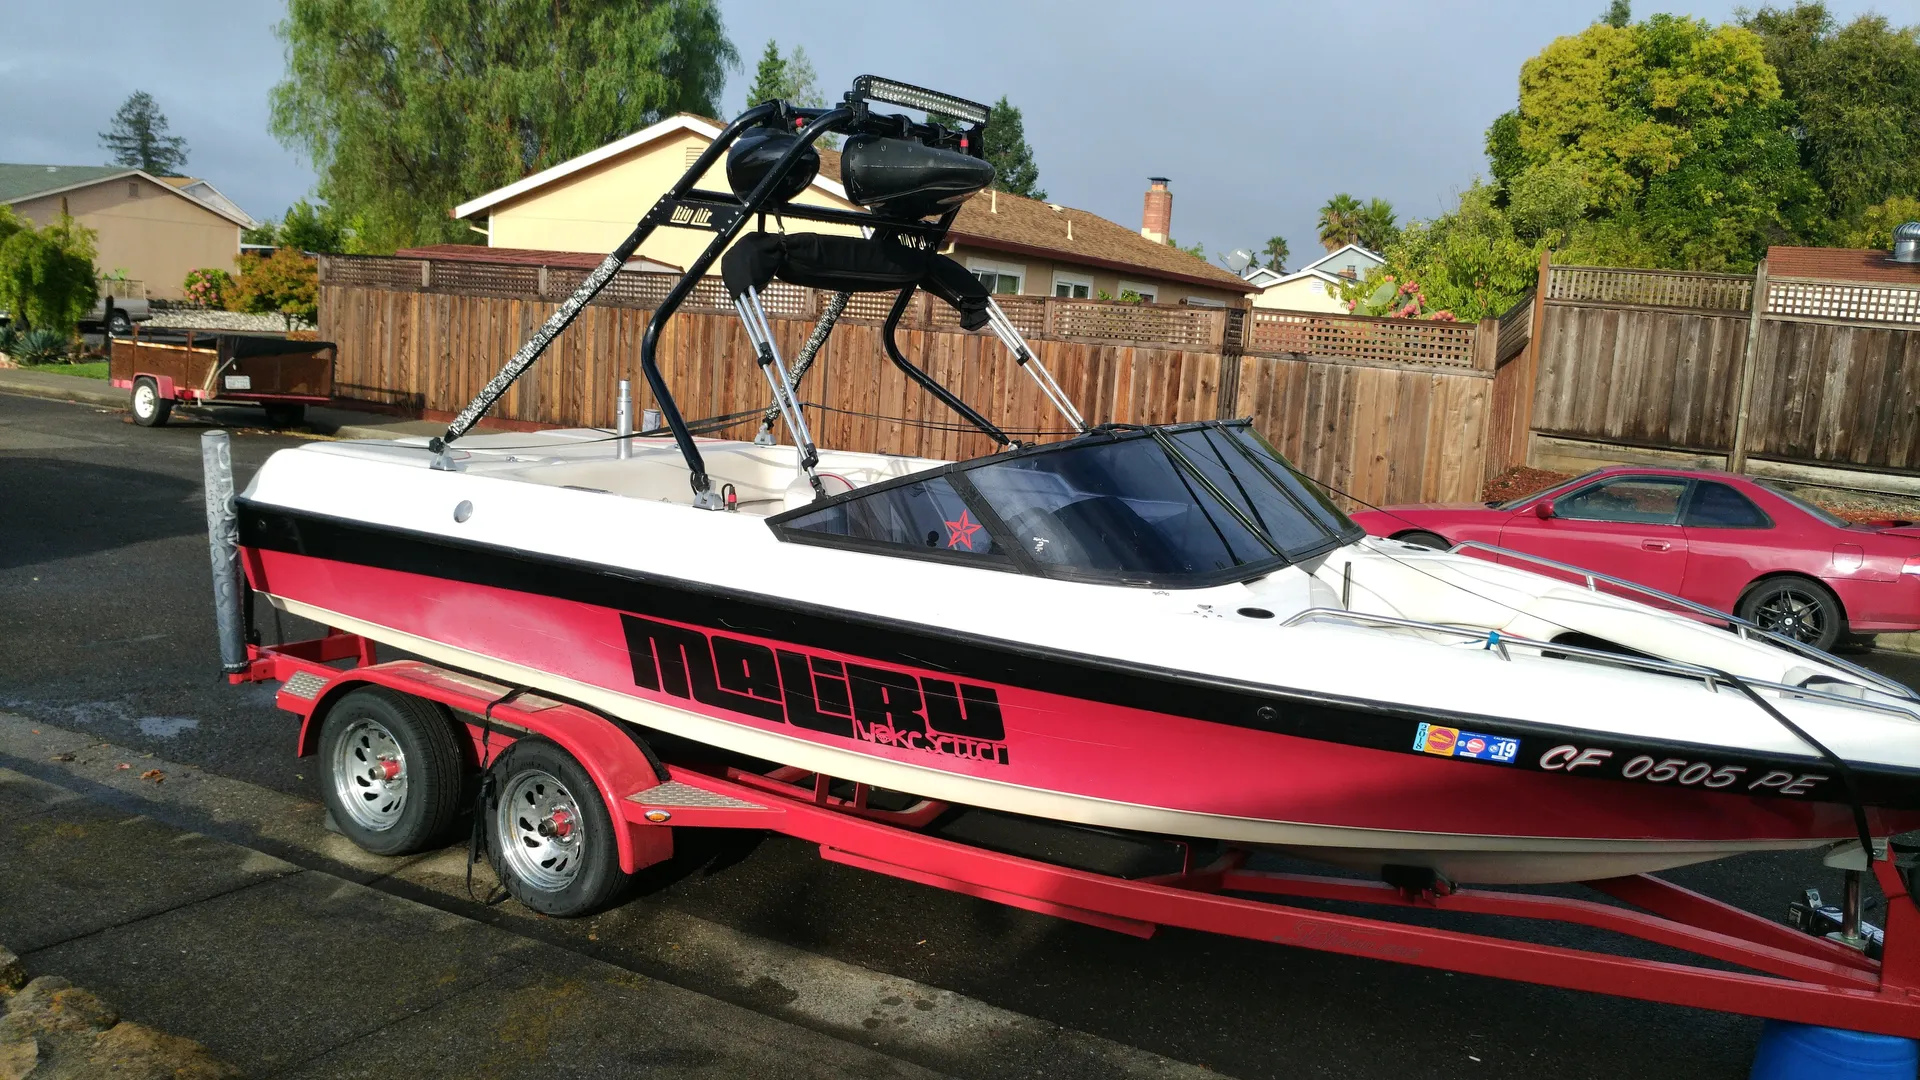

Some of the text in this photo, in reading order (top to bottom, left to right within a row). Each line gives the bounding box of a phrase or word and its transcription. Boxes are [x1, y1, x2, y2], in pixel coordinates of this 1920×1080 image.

[670, 205, 713, 227] Big Air
[1415, 723, 1428, 750] 2018
[1497, 741, 1517, 758] 19
[1539, 744, 1830, 795] CF 0505 PE
